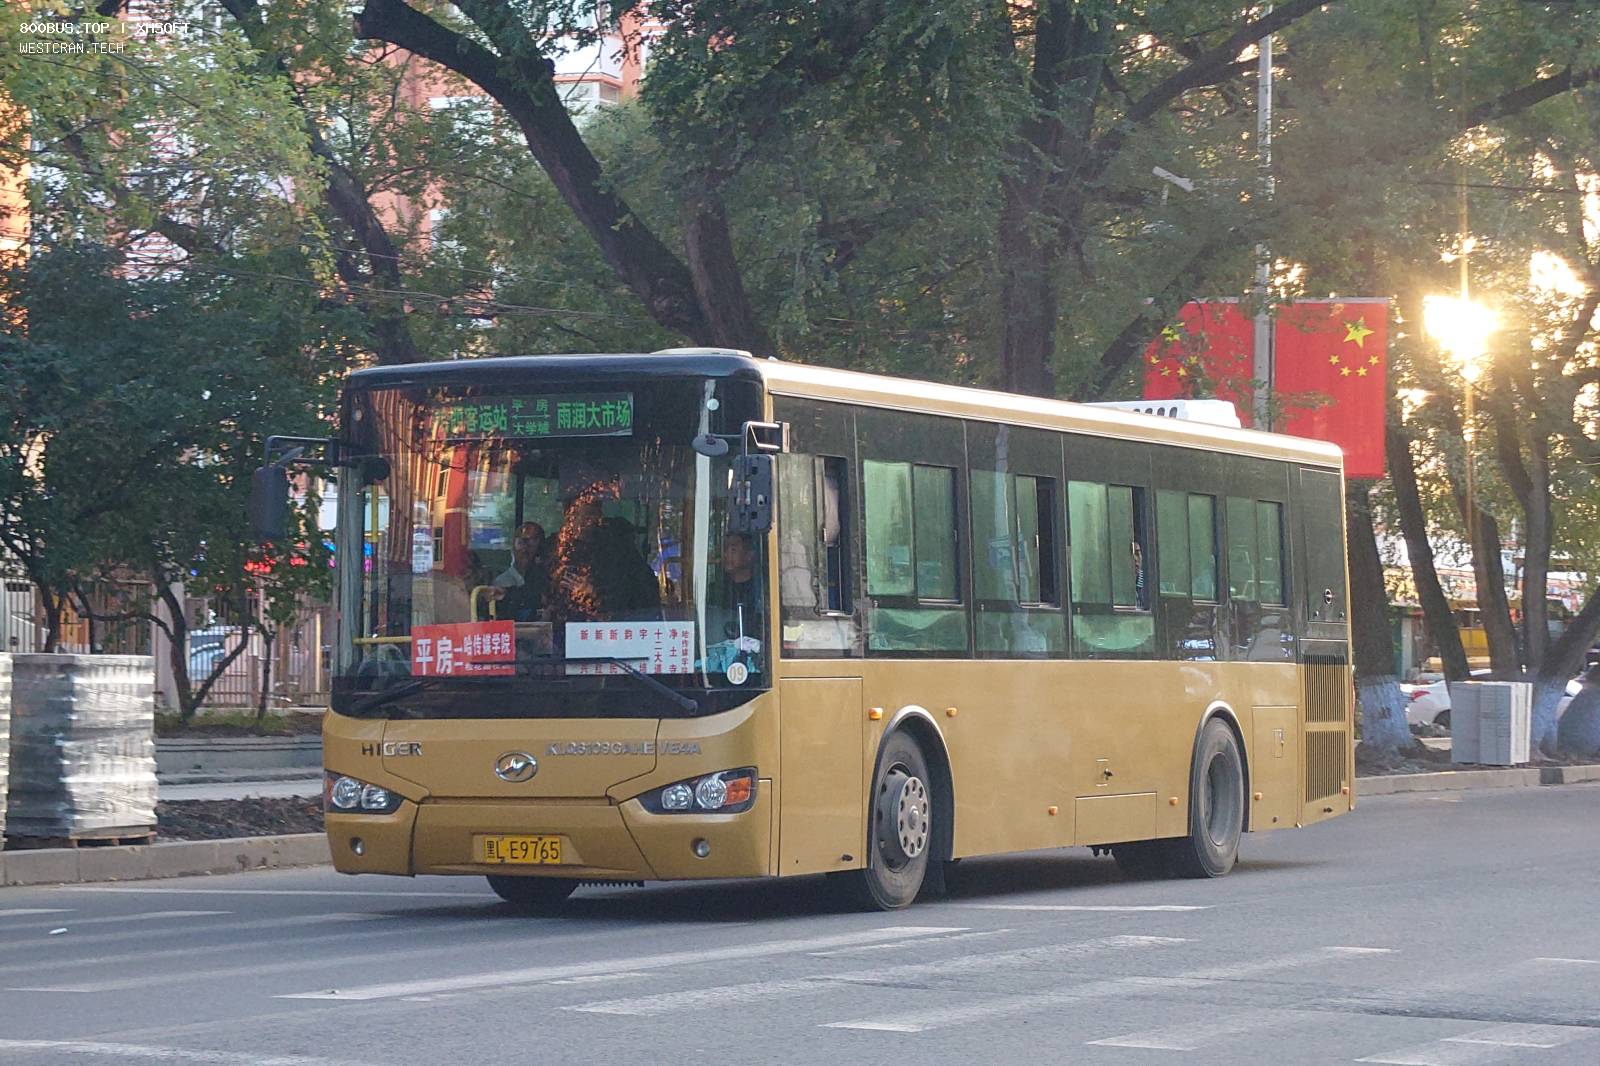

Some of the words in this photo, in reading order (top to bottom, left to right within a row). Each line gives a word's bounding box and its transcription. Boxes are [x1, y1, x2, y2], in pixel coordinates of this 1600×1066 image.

[557, 400, 631, 429] 雨润大市场
[415, 635, 454, 675] 平房
[729, 665, 744, 682] 09
[361, 741, 423, 756] HIGER
